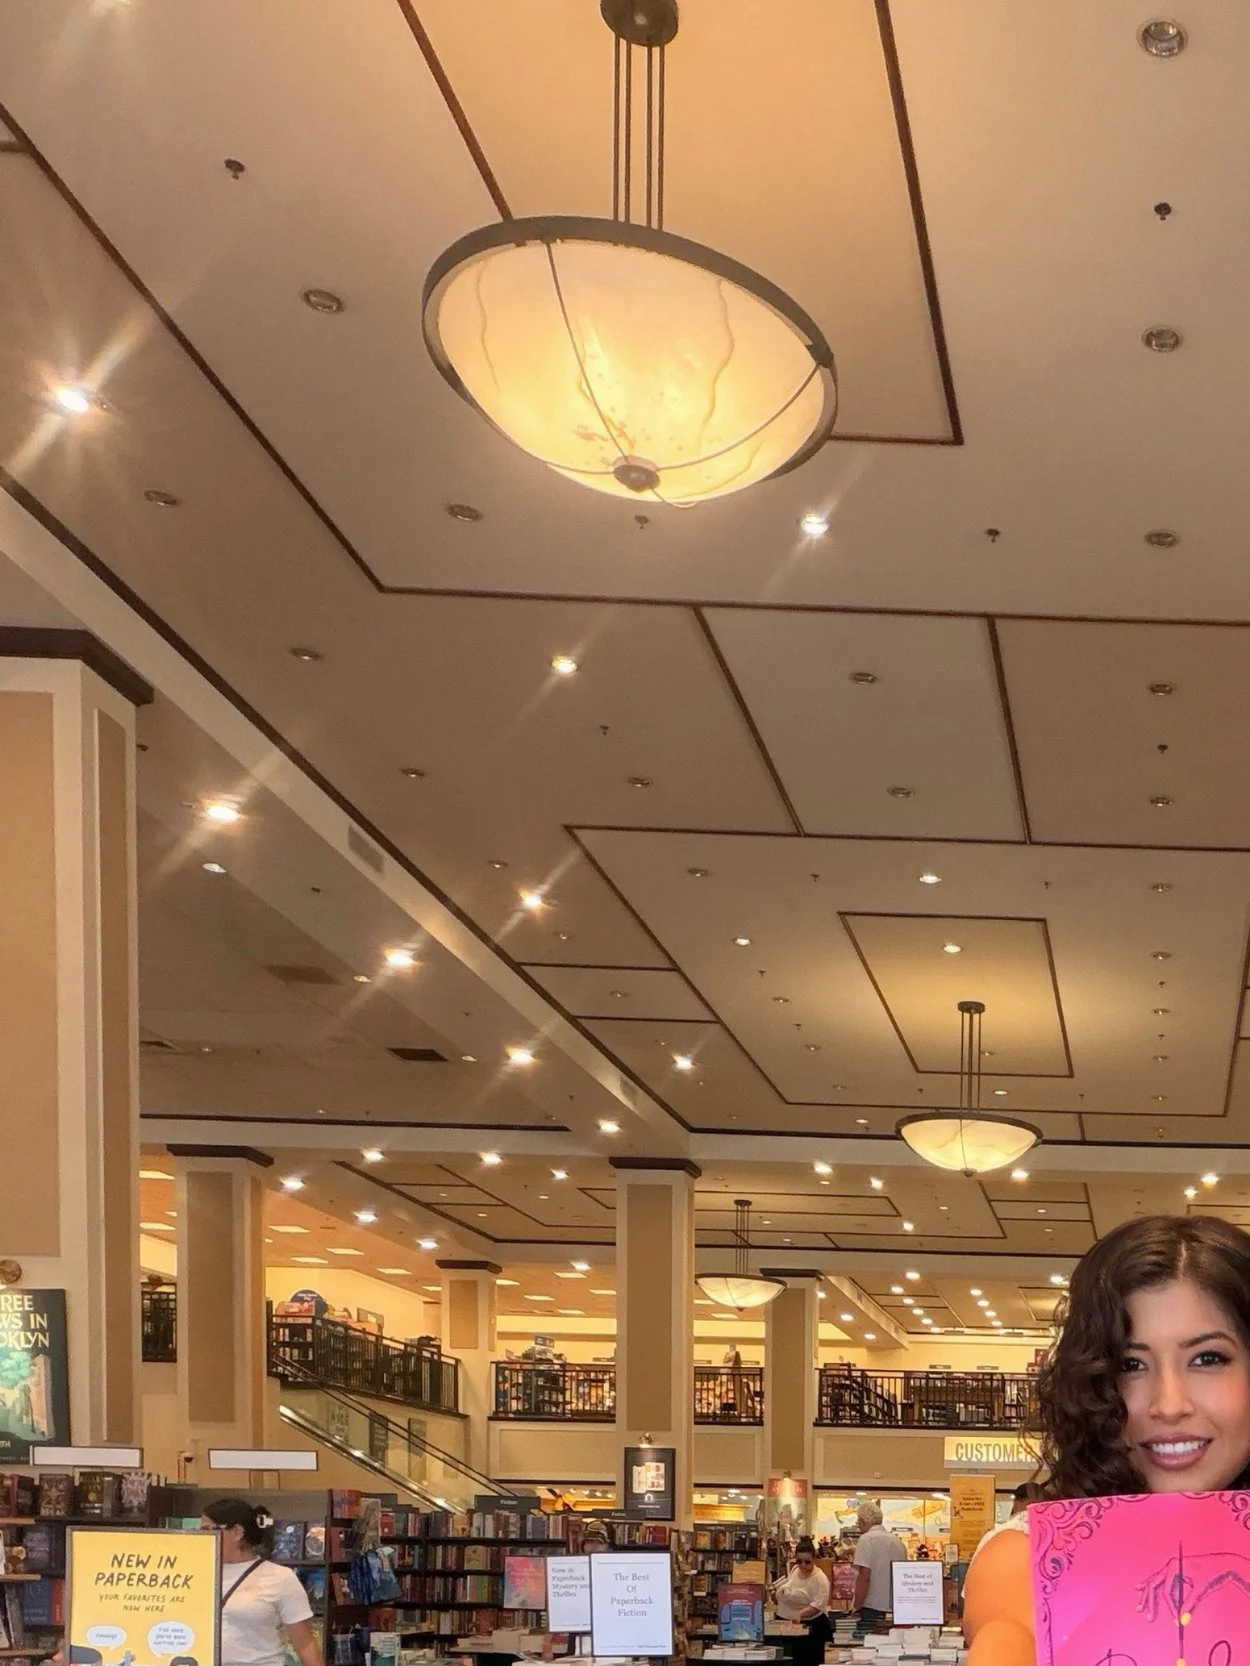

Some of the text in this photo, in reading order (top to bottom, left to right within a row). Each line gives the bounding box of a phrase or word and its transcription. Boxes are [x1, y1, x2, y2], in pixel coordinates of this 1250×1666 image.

[0, 1294, 34, 1312] REE
[30, 1313, 48, 1330] IN
[0, 1331, 50, 1351] OKLYN
[111, 1553, 178, 1569] NEW IN
[95, 1572, 194, 1589] PAPERBACK
[614, 1573, 650, 1581] The Best
[626, 1585, 637, 1593] Of
[99, 1593, 119, 1603] YOUR
[123, 1593, 166, 1603] FAVORITES
[610, 1597, 653, 1606] Paperback
[618, 1609, 647, 1617] Fiction
